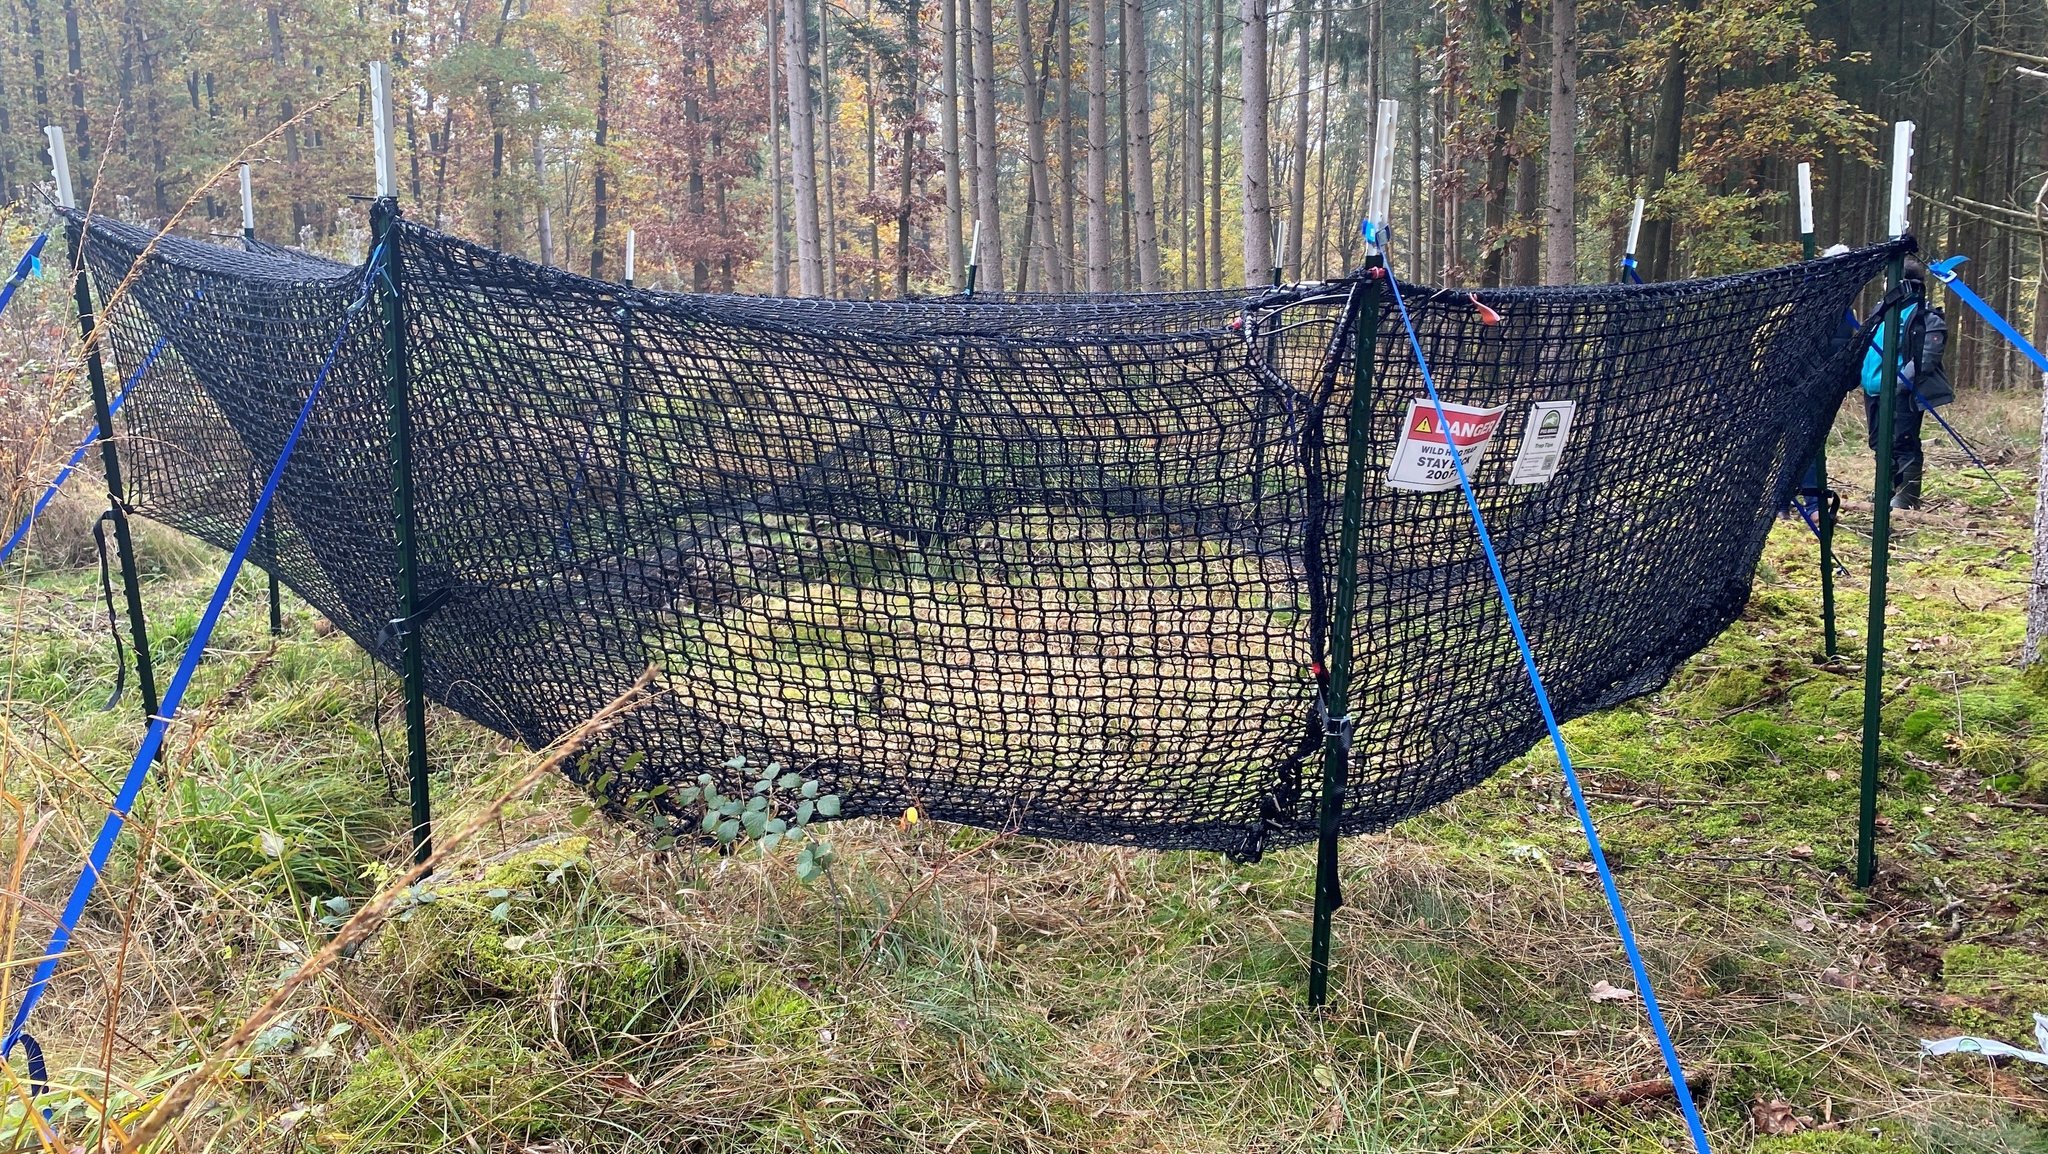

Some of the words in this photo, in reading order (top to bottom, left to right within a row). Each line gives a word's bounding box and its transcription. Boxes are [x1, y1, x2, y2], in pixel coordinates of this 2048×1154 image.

[1435, 418, 1496, 437] DANGER
[1421, 445, 1444, 455] WILD
[1445, 449, 1463, 457] HG
[1417, 457, 1450, 469] STAY
